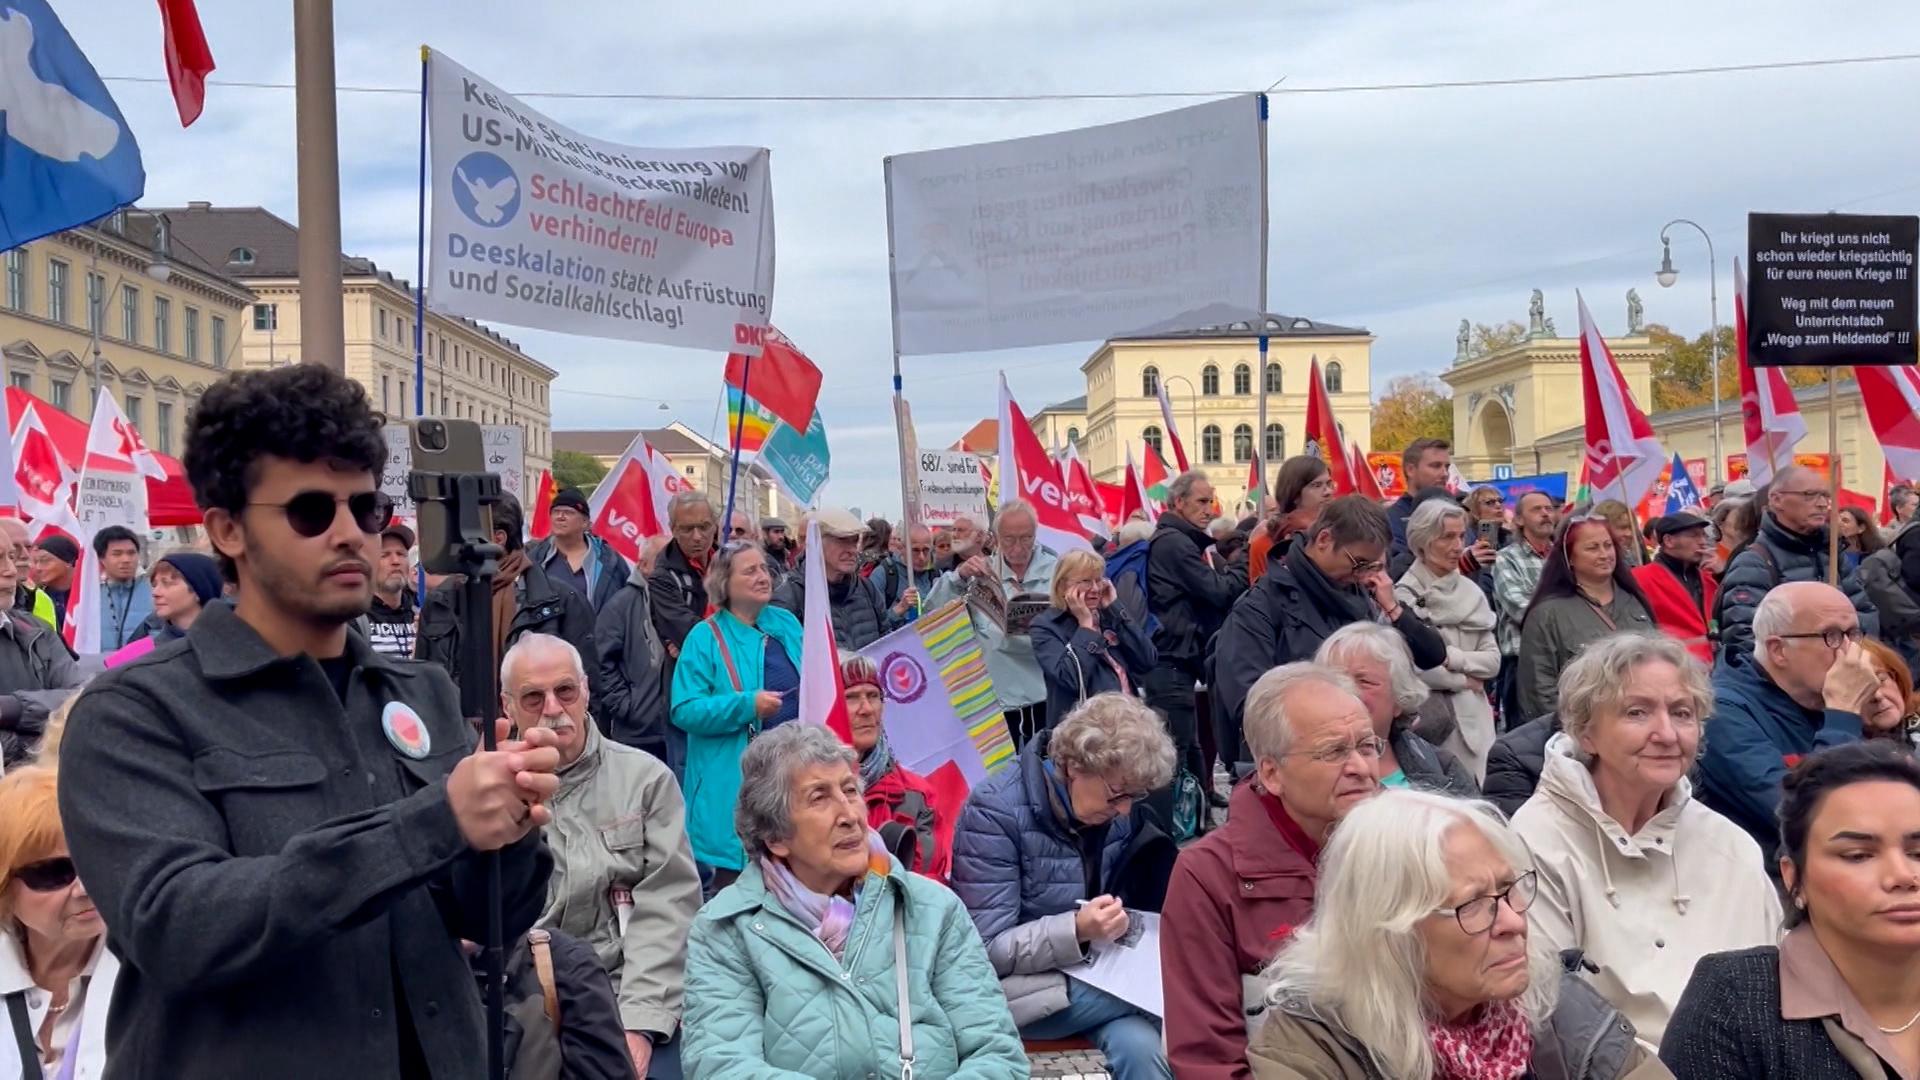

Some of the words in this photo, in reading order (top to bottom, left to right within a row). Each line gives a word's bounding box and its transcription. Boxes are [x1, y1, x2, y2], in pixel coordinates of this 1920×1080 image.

[462, 77, 534, 134] Keine
[537, 121, 713, 177] Stationierung
[720, 159, 748, 182] von
[462, 113, 750, 214] US-Mittelstreckenraketen!
[530, 173, 674, 233] Schlachtfeld
[676, 212, 735, 249] Europa
[529, 211, 658, 259] verhindern!
[1780, 231, 1797, 245] Ihr
[1800, 231, 1834, 248] kriegt
[1837, 233, 1859, 245] uns
[1861, 232, 1890, 245] nicht
[448, 232, 606, 285] Deeskalation
[609, 268, 654, 296] statt
[656, 277, 767, 314] Aufrüstung
[1755, 249, 1794, 263] schon
[1797, 250, 1836, 263] wieder
[1839, 249, 1913, 266] kriegstüchtig
[1766, 267, 1783, 280] für
[1786, 270, 1814, 281] eure
[1816, 270, 1853, 281] neuen
[1855, 267, 1893, 284] Kriege
[1895, 267, 1908, 280] !!!
[450, 268, 498, 295] und
[505, 274, 685, 329] Sozialkahlschlag!
[1780, 297, 1807, 312] Weg
[1810, 297, 1829, 309] mit
[1832, 297, 1857, 309] dem
[1859, 298, 1895, 309] neuen
[1795, 315, 1884, 328] Unterrichtsfach
[1804, 334, 1830, 345] zum
[1897, 332, 1911, 344] !!!
